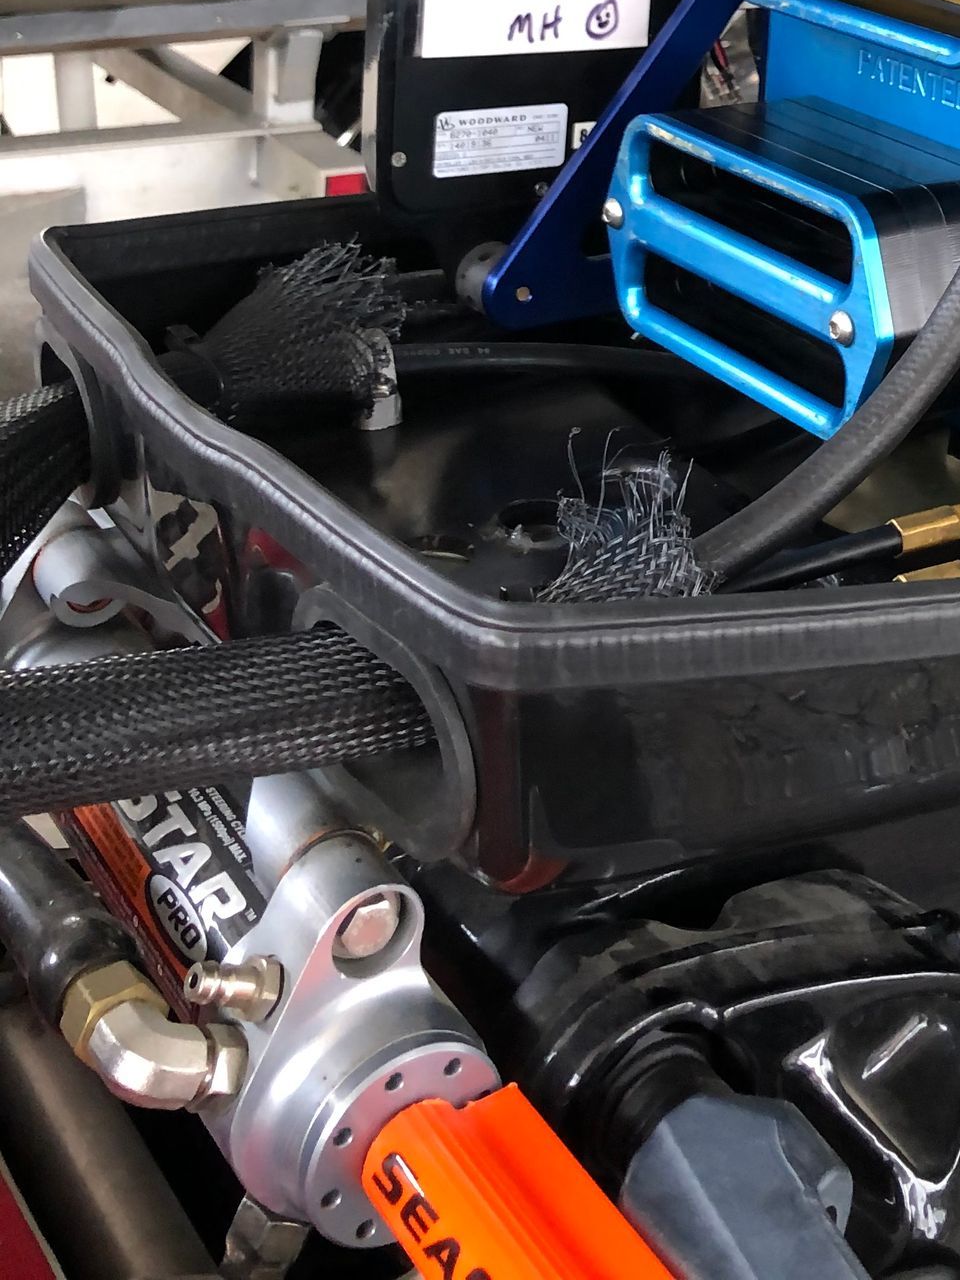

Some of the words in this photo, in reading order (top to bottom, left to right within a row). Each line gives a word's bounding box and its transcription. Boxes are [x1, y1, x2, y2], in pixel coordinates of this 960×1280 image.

[507, 5, 563, 44] MH
[458, 114, 527, 127] WOODWARD
[205, 786, 237, 822] STEERING
[156, 887, 201, 951] PRO
